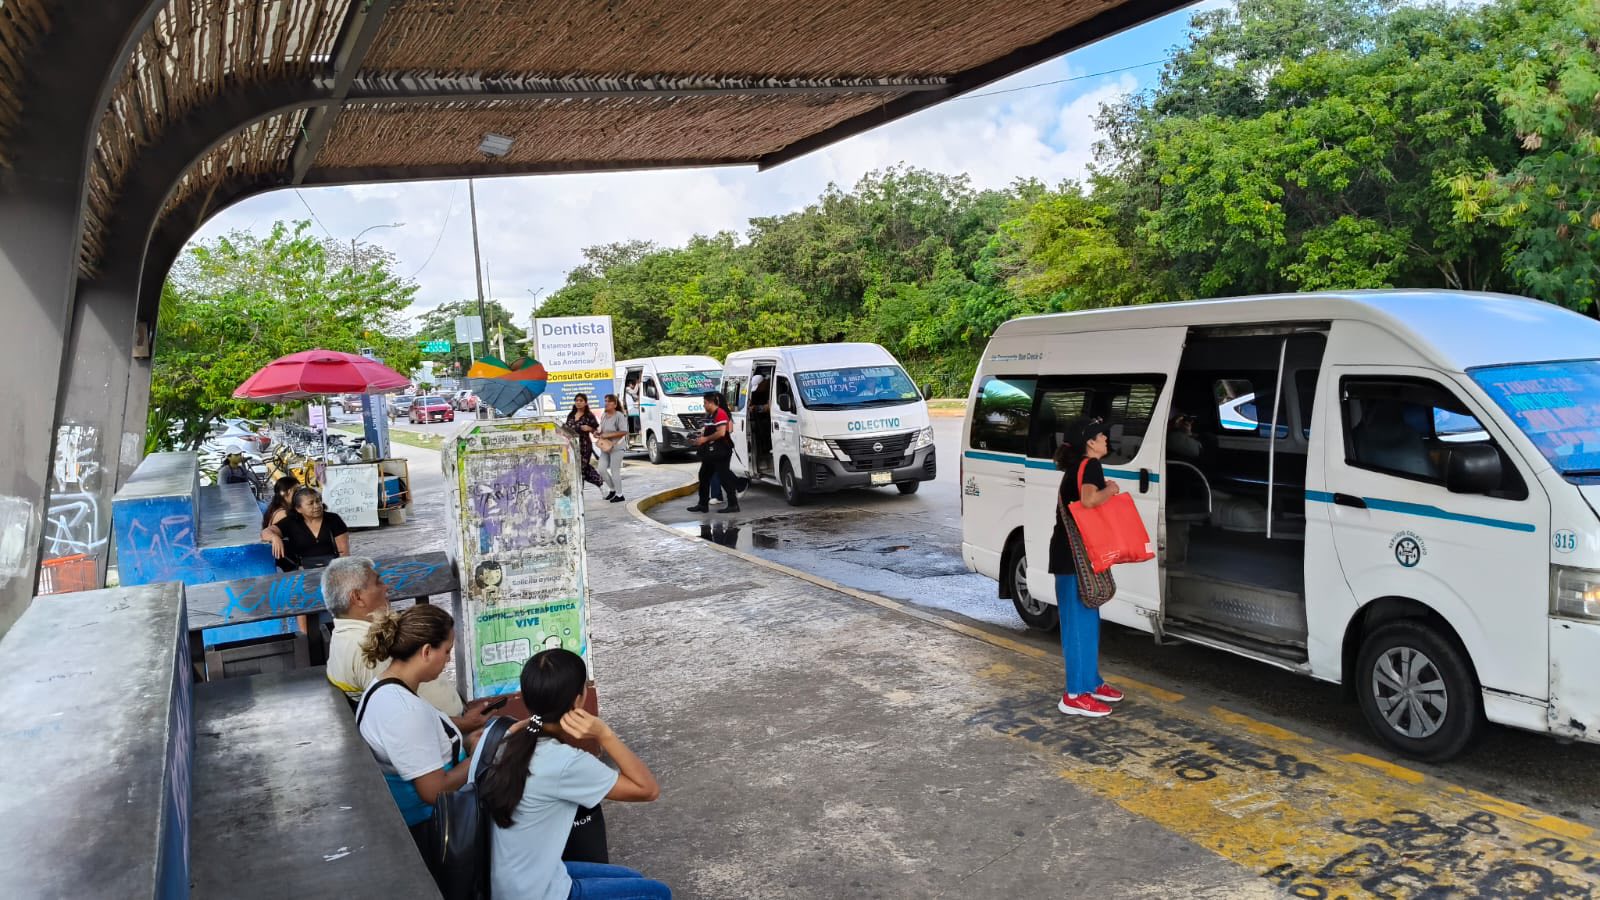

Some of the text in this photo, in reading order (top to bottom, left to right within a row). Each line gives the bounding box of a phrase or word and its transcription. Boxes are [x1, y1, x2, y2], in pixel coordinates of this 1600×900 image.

[542, 322, 605, 336] Dentista
[547, 373, 582, 381] Consulta
[847, 418, 900, 431] COLECTIVO
[1388, 530, 1428, 556] SERVICIO COLECTIVO
[1555, 534, 1575, 548] 315
[526, 603, 576, 614] TERAPEUTICA
[515, 617, 540, 628] VIVE
